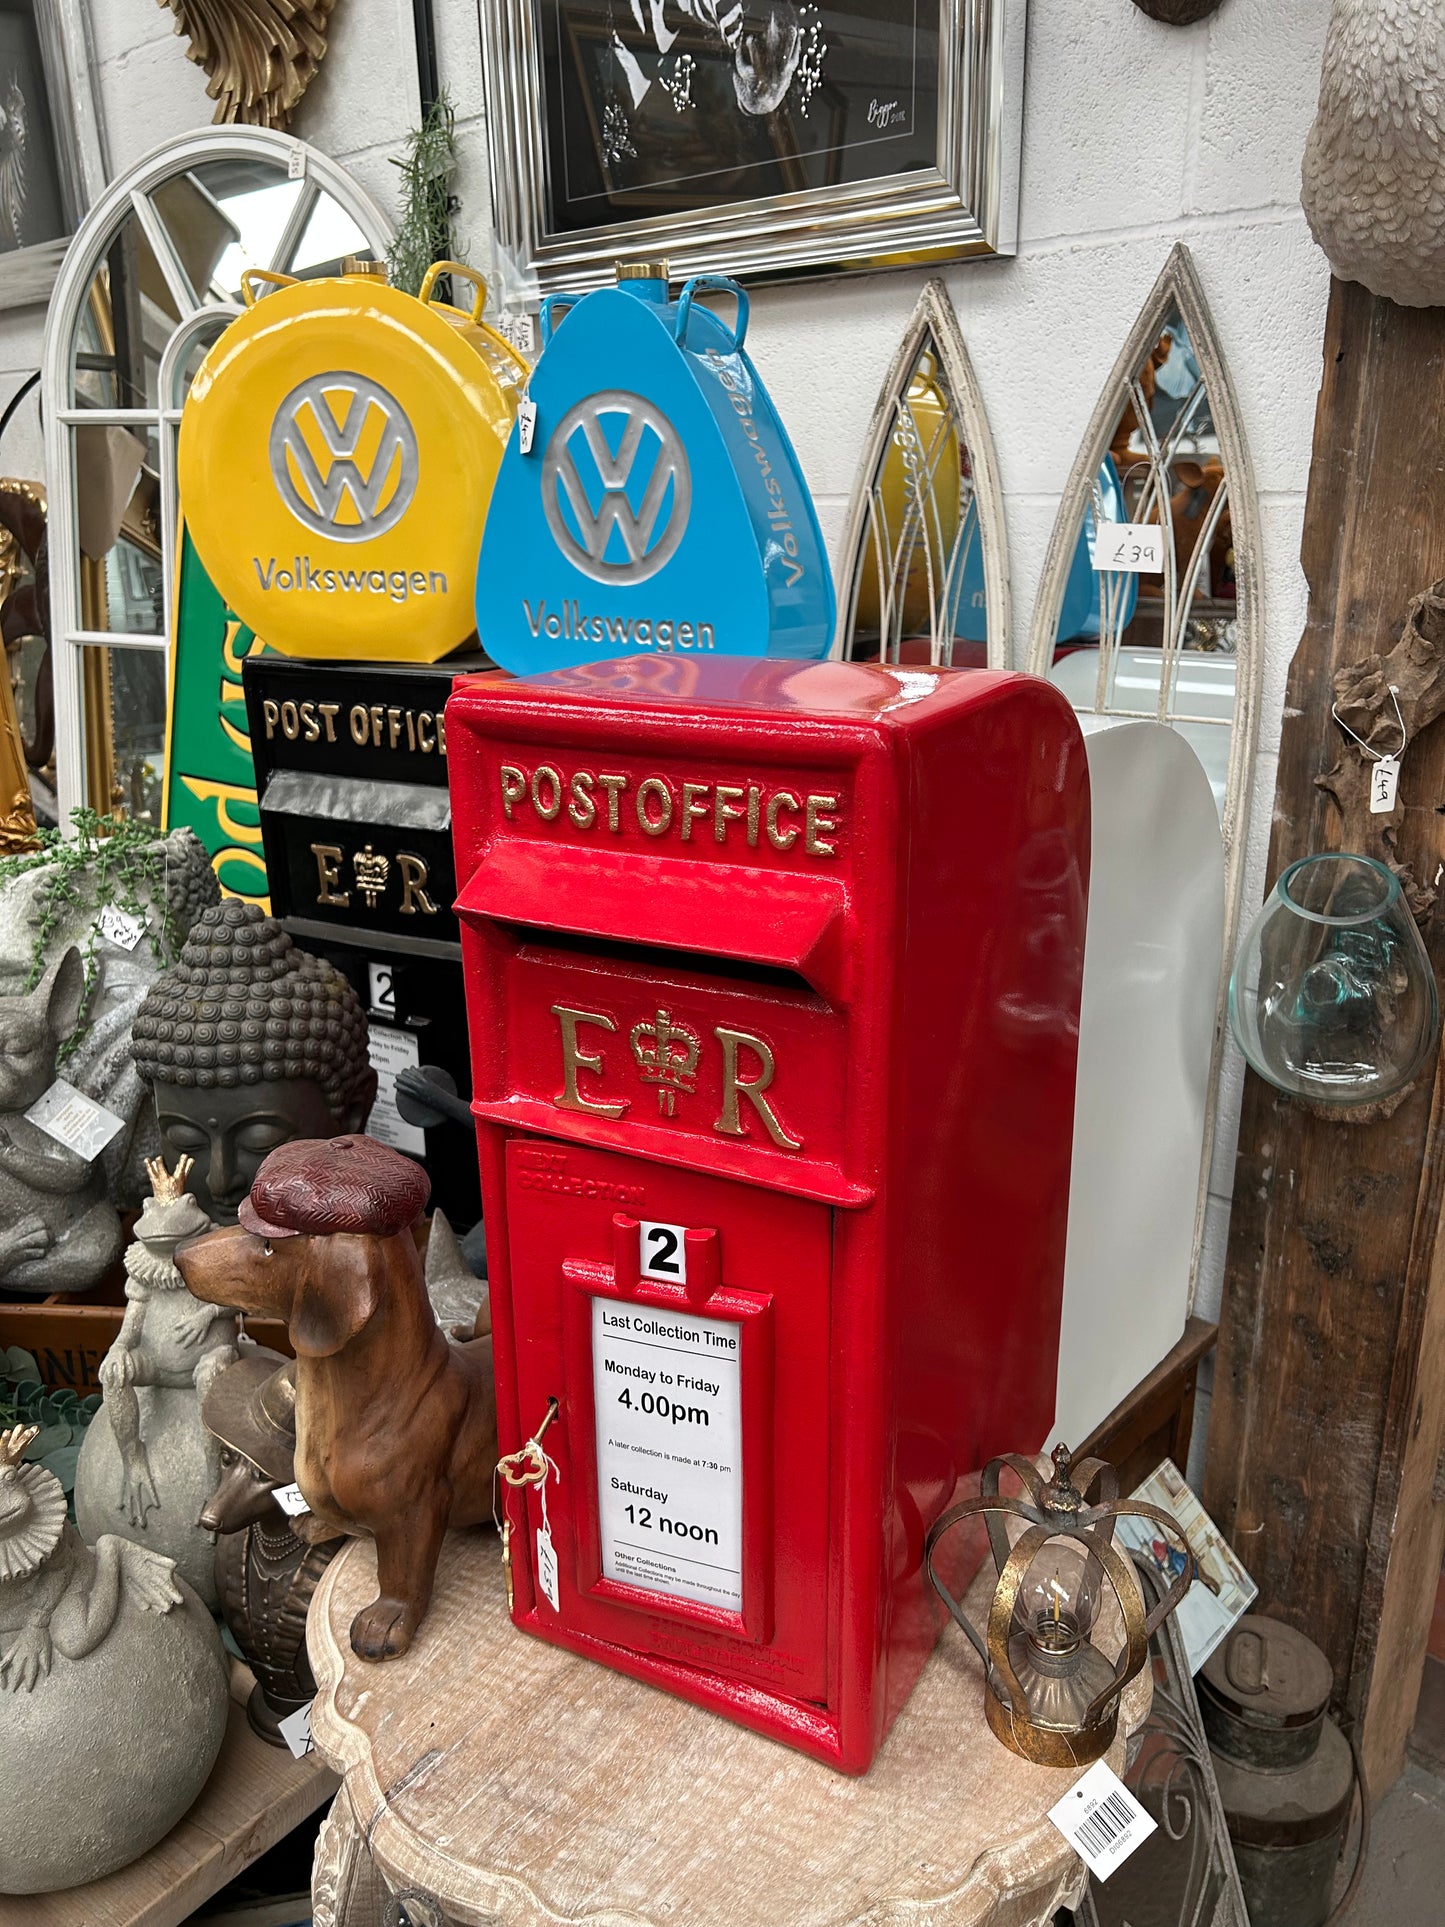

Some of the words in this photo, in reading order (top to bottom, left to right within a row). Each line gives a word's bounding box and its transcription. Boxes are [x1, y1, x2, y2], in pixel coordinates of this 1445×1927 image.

[274, 376, 414, 538] VW
[705, 348, 804, 588] Volkswagen
[546, 395, 687, 578] VW
[1113, 543, 1157, 565] £39
[253, 556, 448, 603] Volkswagen
[523, 599, 715, 652] Volkswagen
[263, 700, 341, 743] POST
[350, 704, 447, 755] OFFICE
[1375, 768, 1393, 803] £49
[310, 842, 350, 908] E
[396, 852, 438, 915] R
[376, 971, 396, 1007] 2
[550, 1004, 631, 1119] E
[713, 1026, 803, 1150] R
[516, 1170, 647, 1207] COLLECTION
[647, 1227, 680, 1275] 2
[602, 1311, 631, 1330] Last
[633, 1318, 700, 1343] Collection
[703, 1331, 737, 1350] Time
[604, 1359, 656, 1384] Monday
[660, 1371, 673, 1385] to
[677, 1374, 720, 1397] Friday
[617, 1387, 709, 1427] 4.00pm
[608, 1438, 614, 1446] A
[614, 1439, 630, 1451] later
[631, 1444, 663, 1459] collection
[664, 1451, 671, 1460] is
[671, 1454, 692, 1465] made
[693, 1459, 701, 1467] at
[701, 1460, 718, 1471] 7:30
[719, 1465, 732, 1473] pm
[611, 1477, 669, 1505] Saturday
[624, 1504, 652, 1529] 12
[659, 1516, 719, 1546] noon
[614, 1551, 635, 1562] Other
[636, 1556, 677, 1573] Collections
[1083, 1798, 1099, 1815] 6892
